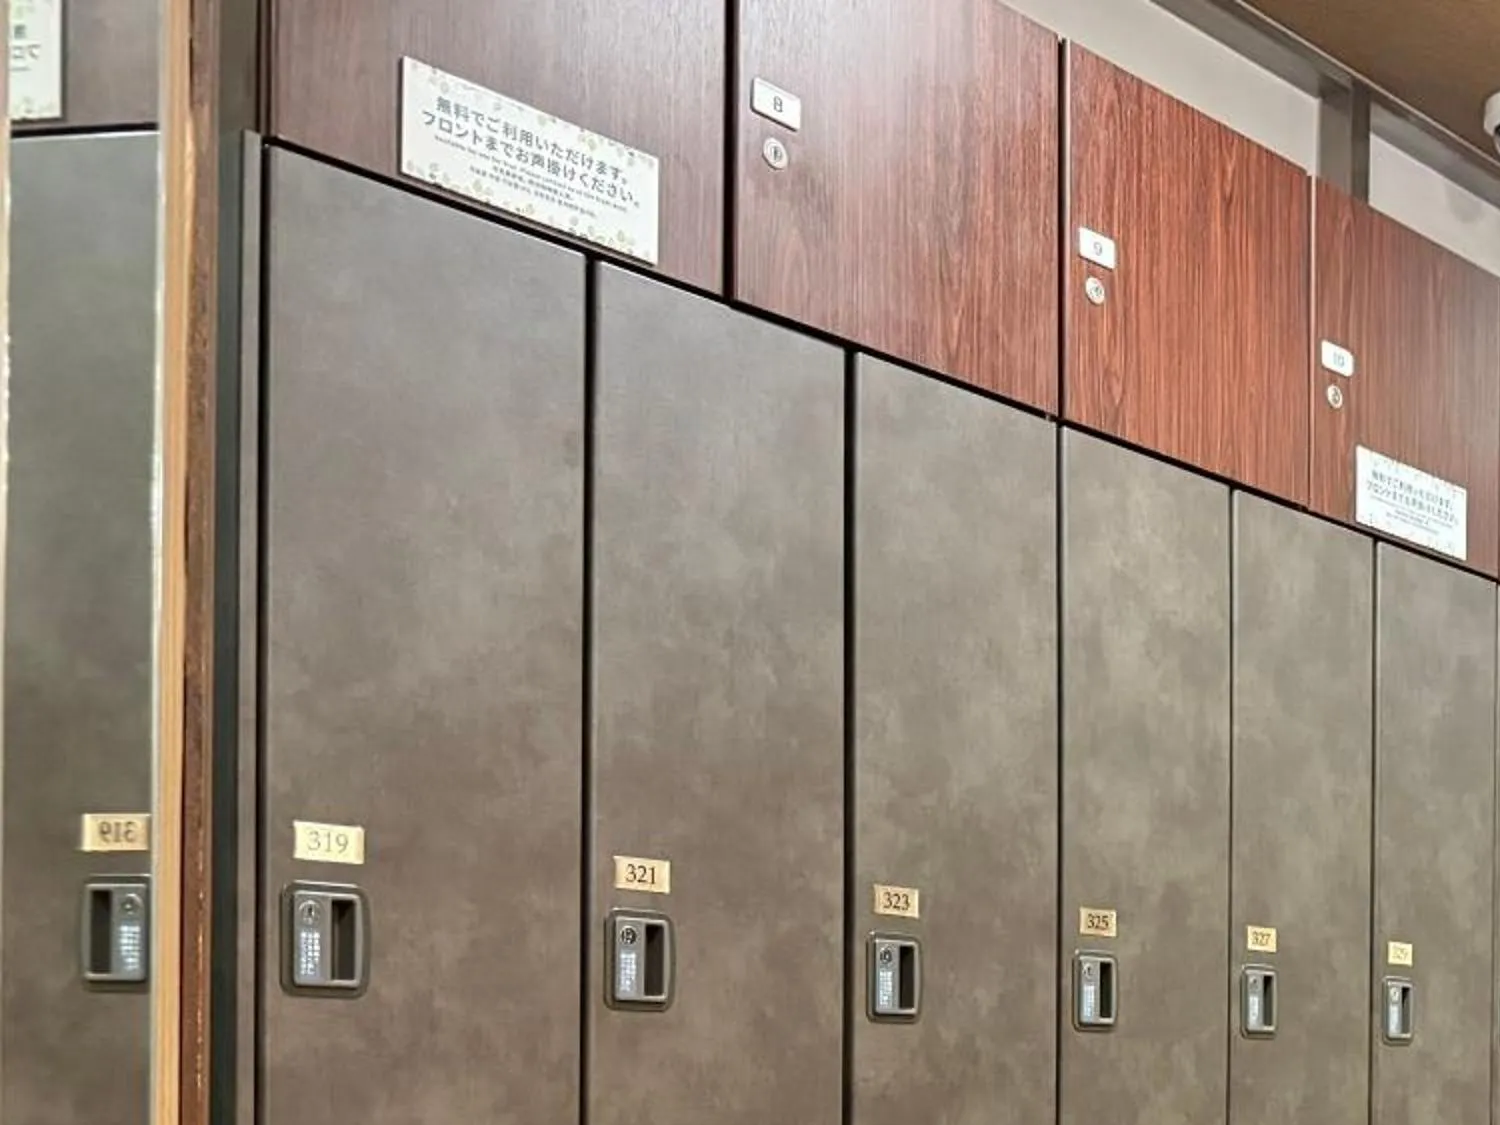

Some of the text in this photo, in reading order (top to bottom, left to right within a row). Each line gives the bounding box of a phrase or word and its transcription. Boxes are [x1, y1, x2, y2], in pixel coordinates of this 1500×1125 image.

[772, 96, 783, 113] 8
[436, 95, 627, 185] 無料でご利用いただけます。
[423, 110, 640, 208] フロントまでお声掛けください。
[1092, 241, 1103, 256] 9
[306, 829, 349, 854] 319
[625, 863, 658, 885] 321
[883, 891, 910, 911] 323
[1087, 913, 1109, 929] 325
